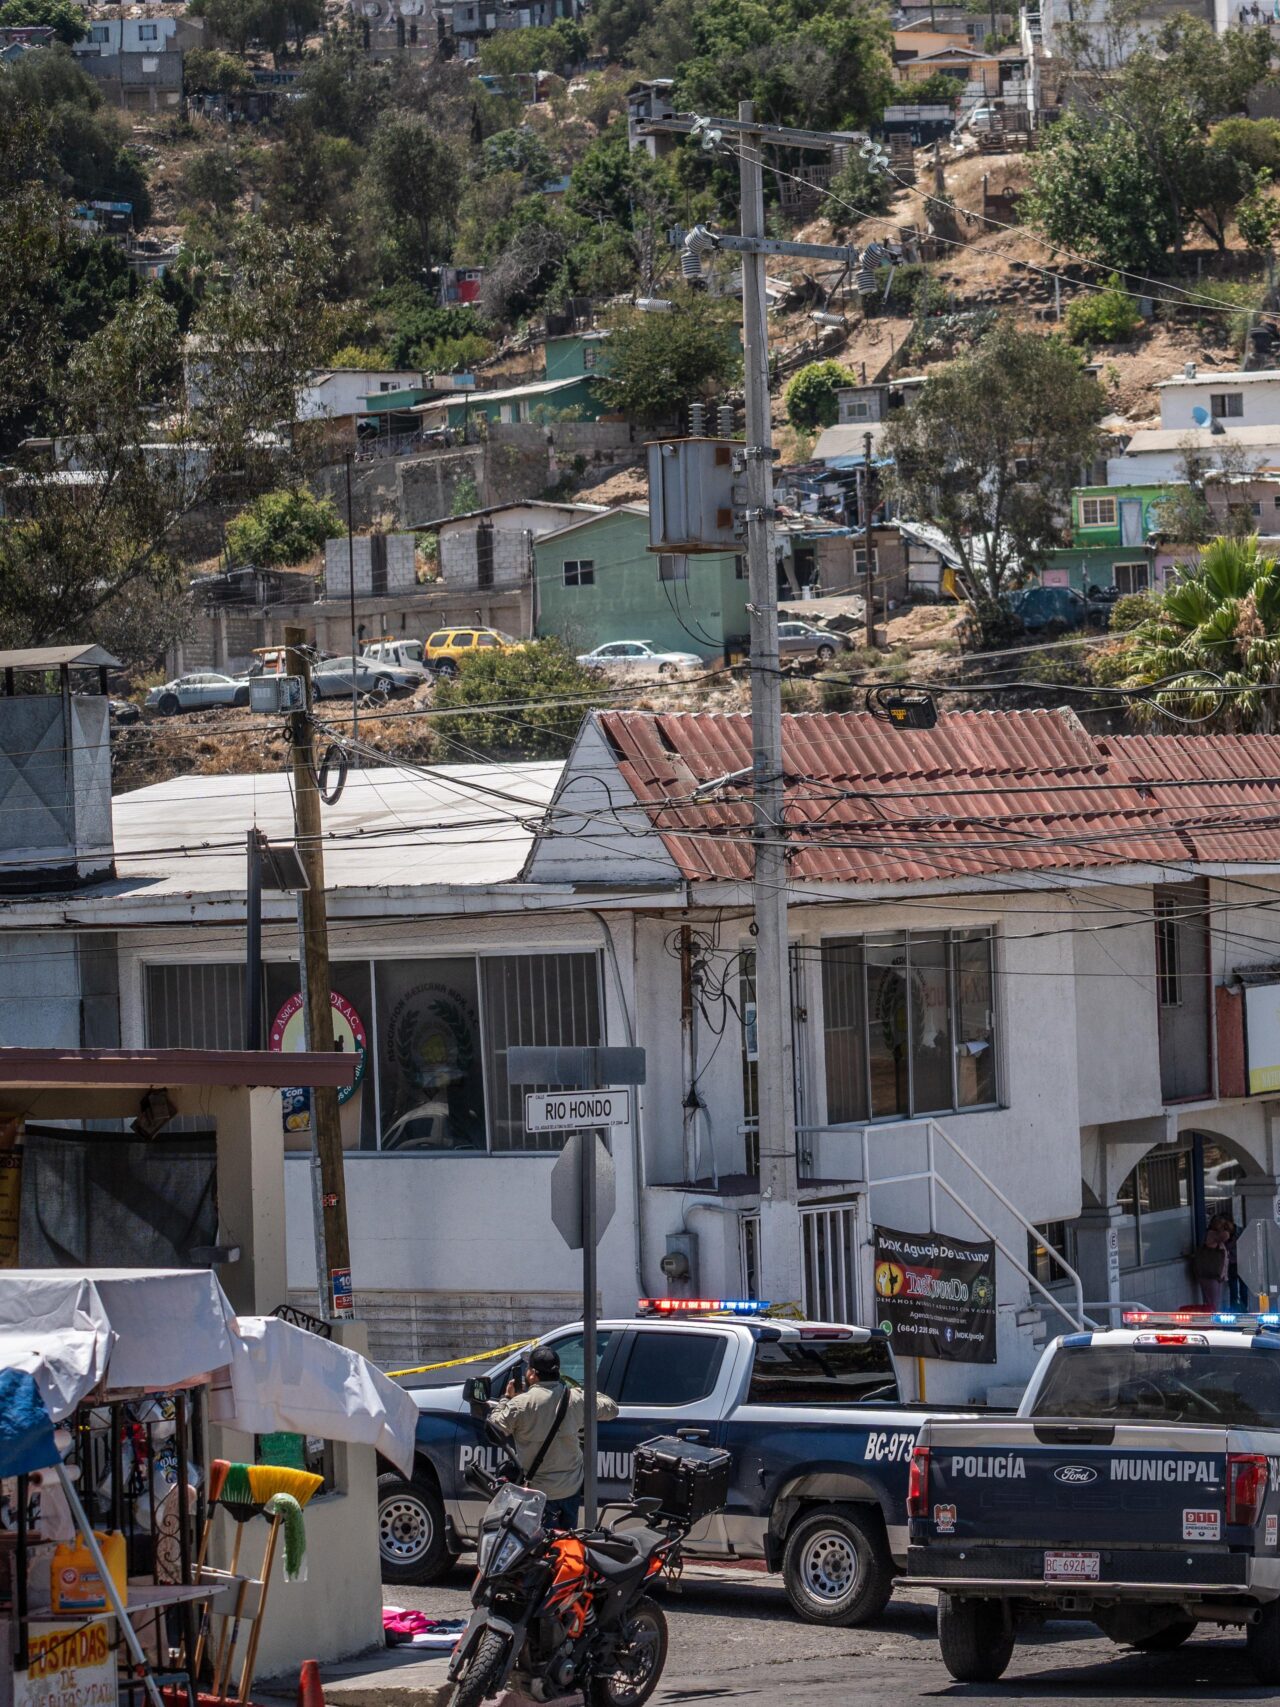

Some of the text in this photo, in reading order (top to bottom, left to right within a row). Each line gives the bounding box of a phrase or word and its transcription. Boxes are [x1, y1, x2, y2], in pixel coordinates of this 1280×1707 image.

[276, 1002, 295, 1028] Asoc.
[343, 1008, 360, 1029] A.C.
[545, 1099, 612, 1120] RIO HONDO
[903, 1242, 939, 1259] Aguaje
[940, 1246, 954, 1257] De
[955, 1249, 965, 1260] La
[966, 1252, 989, 1263] Tuna
[897, 1323, 918, 1335] (664)
[951, 1453, 1220, 1483] POLICÍA MUNICIPAL
[1060, 1467, 1090, 1482] Ford
[1187, 1513, 1216, 1522] 911
[1046, 1558, 1098, 1573] BC-692A-2
[28, 1625, 106, 1679] TOSTADAS
[60, 1669, 77, 1691] DE
